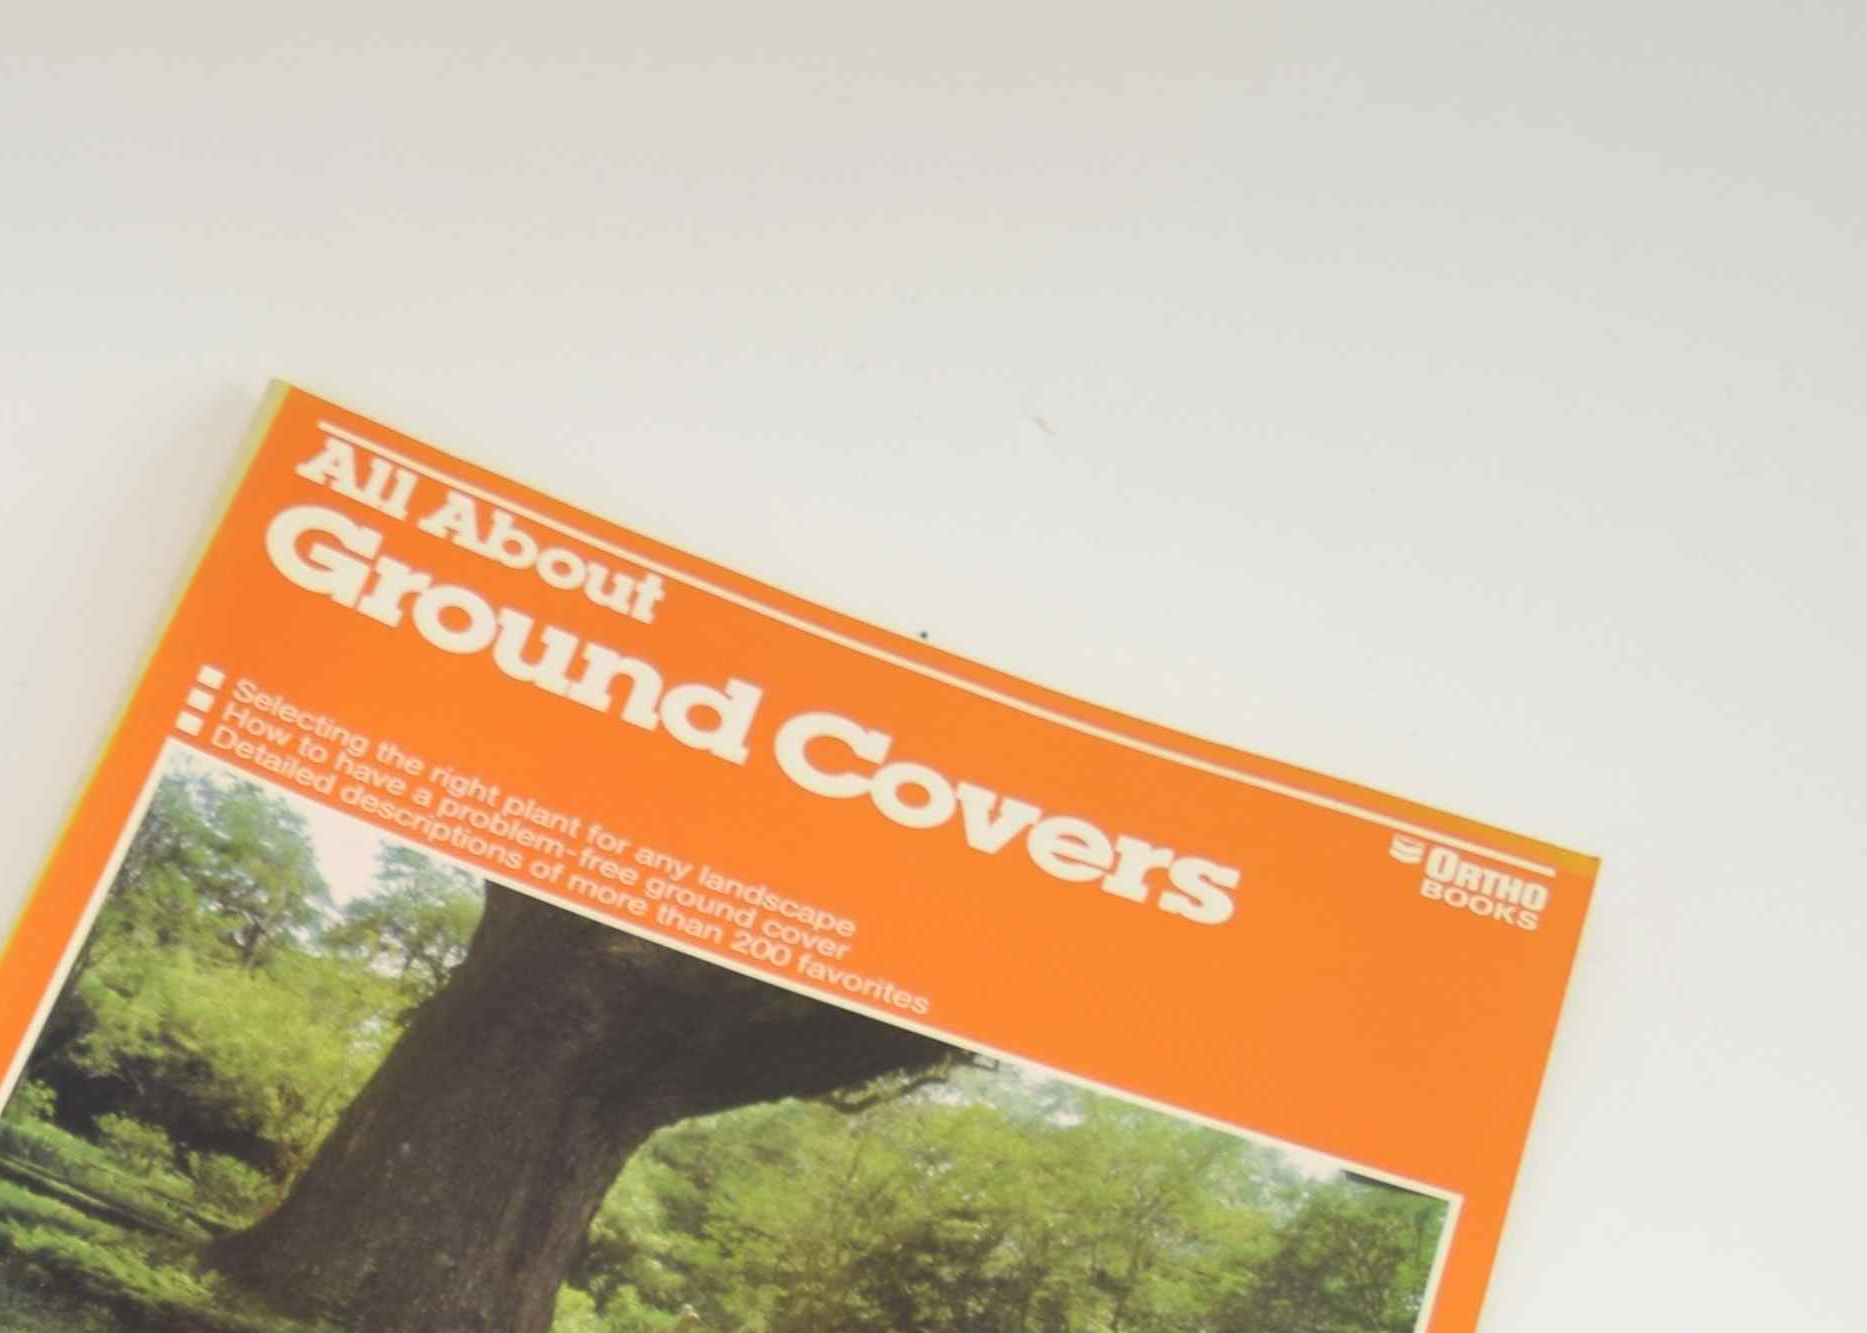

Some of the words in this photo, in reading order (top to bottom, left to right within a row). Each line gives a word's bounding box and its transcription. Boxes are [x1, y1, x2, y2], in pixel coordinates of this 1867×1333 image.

[296, 437, 420, 519] All
[417, 489, 665, 624] About
[221, 700, 291, 747] How
[297, 735, 328, 764] to
[334, 751, 406, 796] have
[411, 785, 432, 806] a
[437, 799, 639, 887] problem-free
[644, 875, 756, 930] ground
[762, 917, 851, 961] cover
[232, 677, 369, 758] Selecting
[375, 741, 425, 776] the
[430, 765, 500, 806] right
[501, 794, 580, 840] plant
[586, 824, 631, 855] for
[634, 845, 692, 881] any
[697, 864, 856, 940] landscape
[265, 504, 763, 766] Ground
[773, 711, 1241, 925] Covers
[209, 724, 336, 795] Detailed
[339, 783, 523, 870] descriptions
[528, 858, 564, 884] of
[566, 872, 648, 917] more
[655, 904, 724, 944] than
[729, 931, 791, 967] 200
[795, 952, 930, 1016] favorites
[1420, 878, 1538, 931] BOOKS
